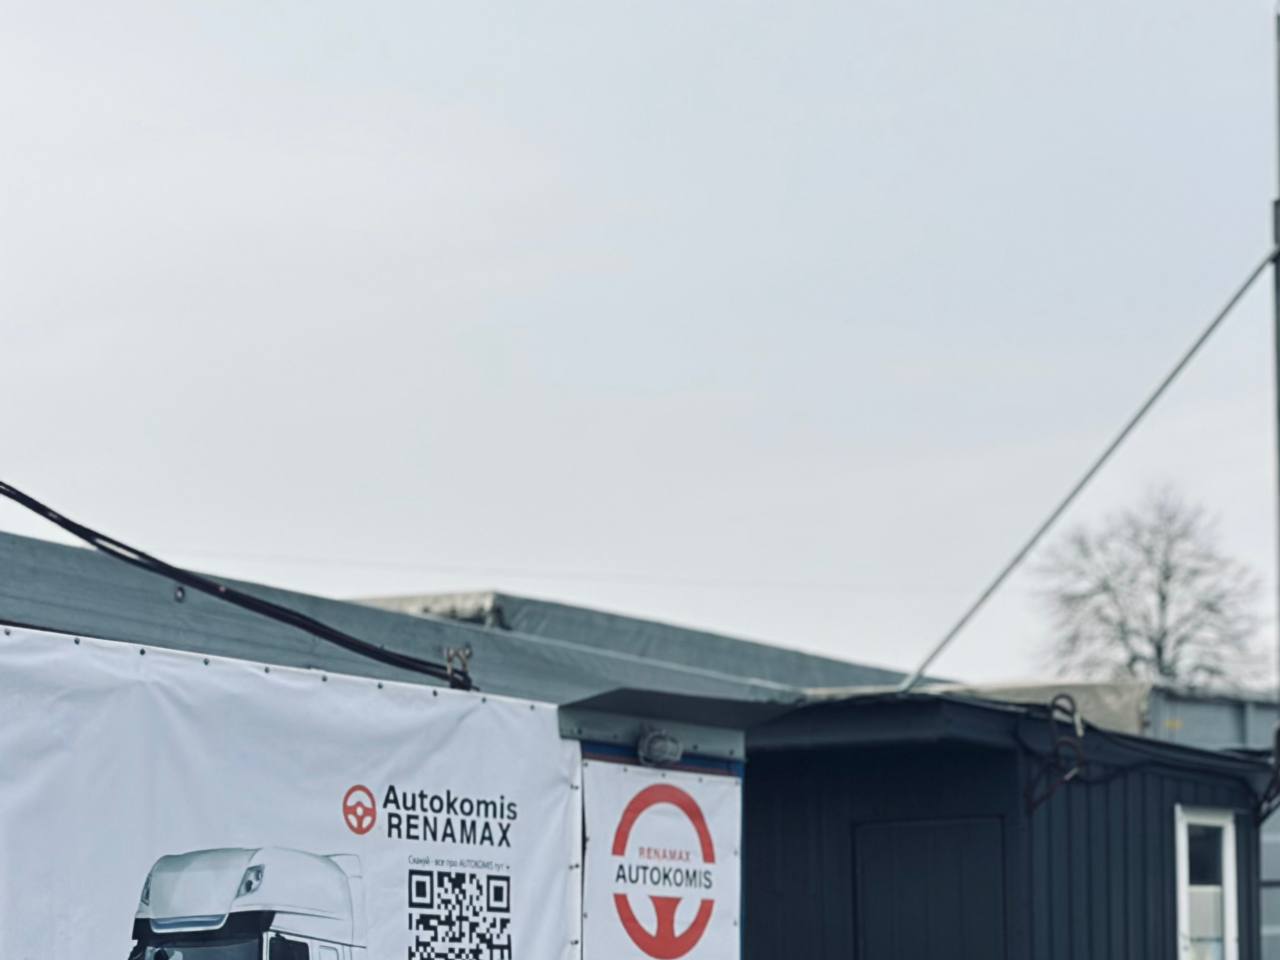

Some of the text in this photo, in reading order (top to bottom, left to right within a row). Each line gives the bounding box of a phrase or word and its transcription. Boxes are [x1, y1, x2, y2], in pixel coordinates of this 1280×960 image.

[382, 784, 518, 821] Autokomis
[387, 811, 511, 848] RENAMAX
[638, 846, 691, 862] RENAMAX
[615, 863, 713, 889] AUTOKOMIS
